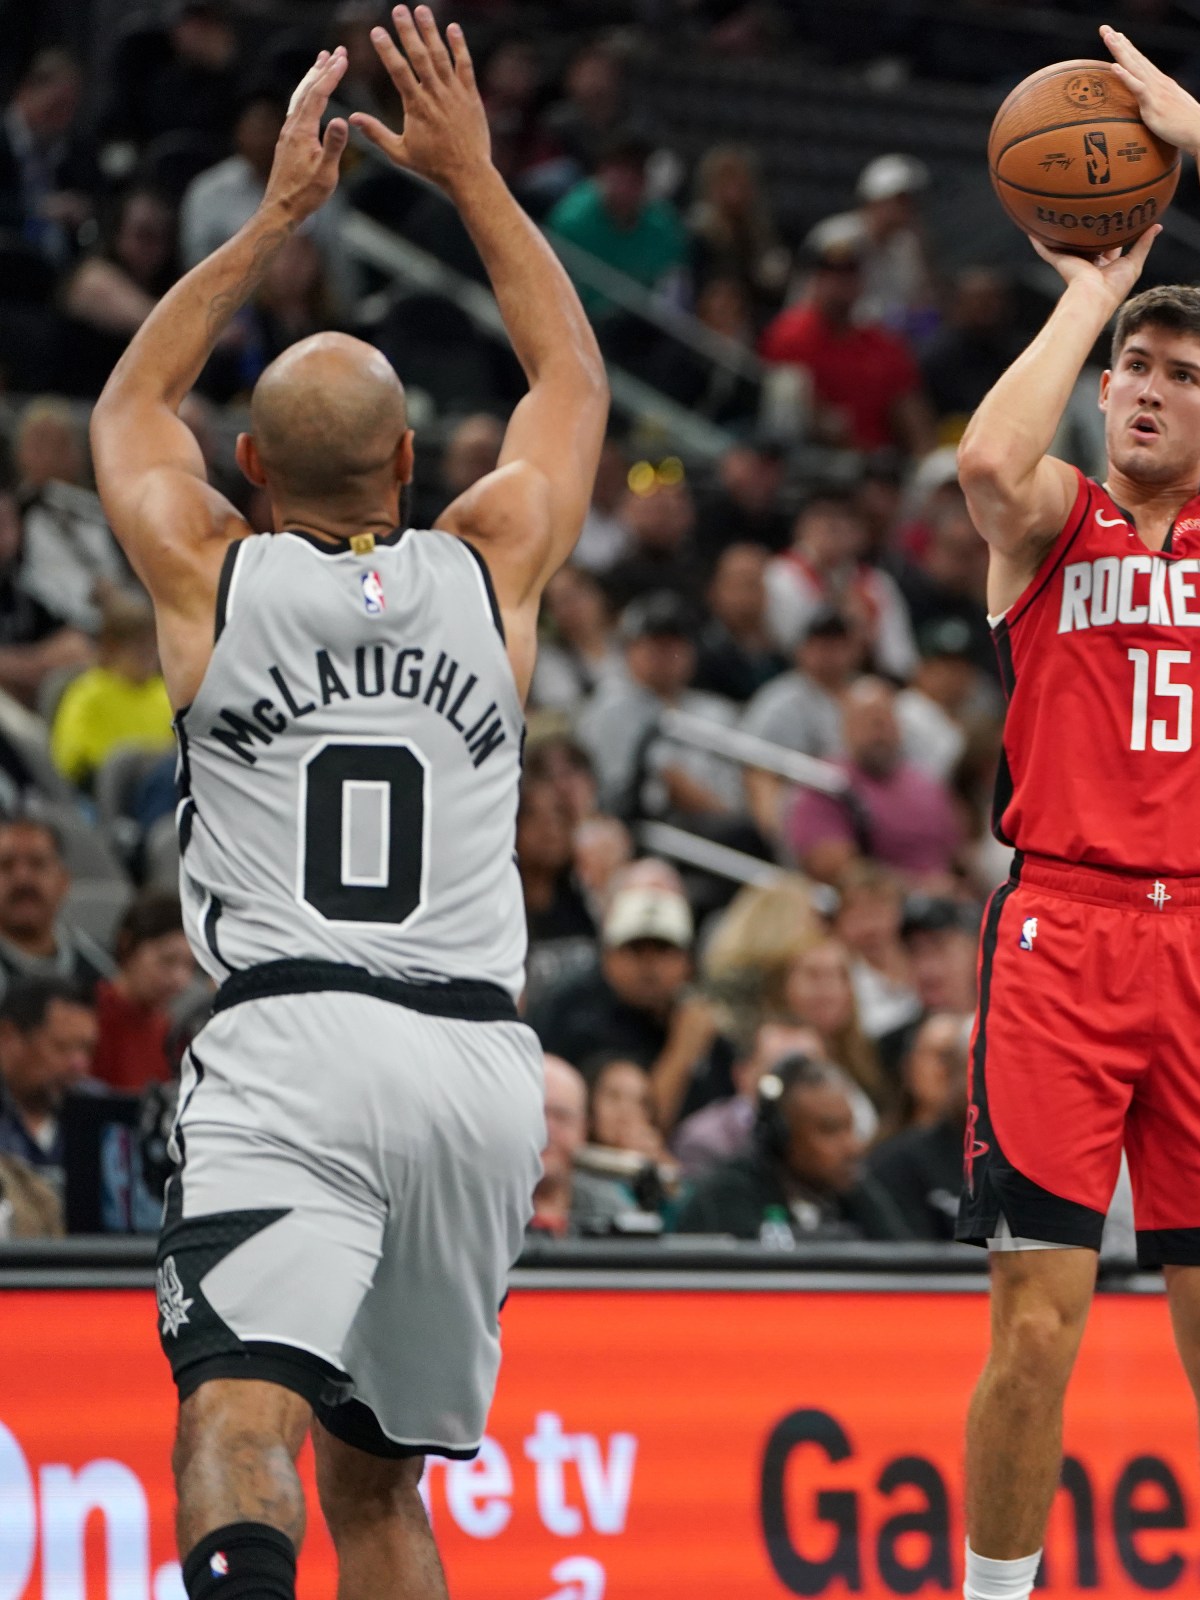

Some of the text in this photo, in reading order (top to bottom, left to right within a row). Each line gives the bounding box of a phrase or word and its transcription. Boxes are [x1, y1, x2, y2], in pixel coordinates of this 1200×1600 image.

[1036, 197, 1158, 236] Wilson
[210, 646, 506, 769] McLAUGHLIN
[1127, 648, 1193, 752] 15
[296, 735, 431, 930] 0
[0, 1419, 190, 1600] n.
[523, 1410, 639, 1538] tv
